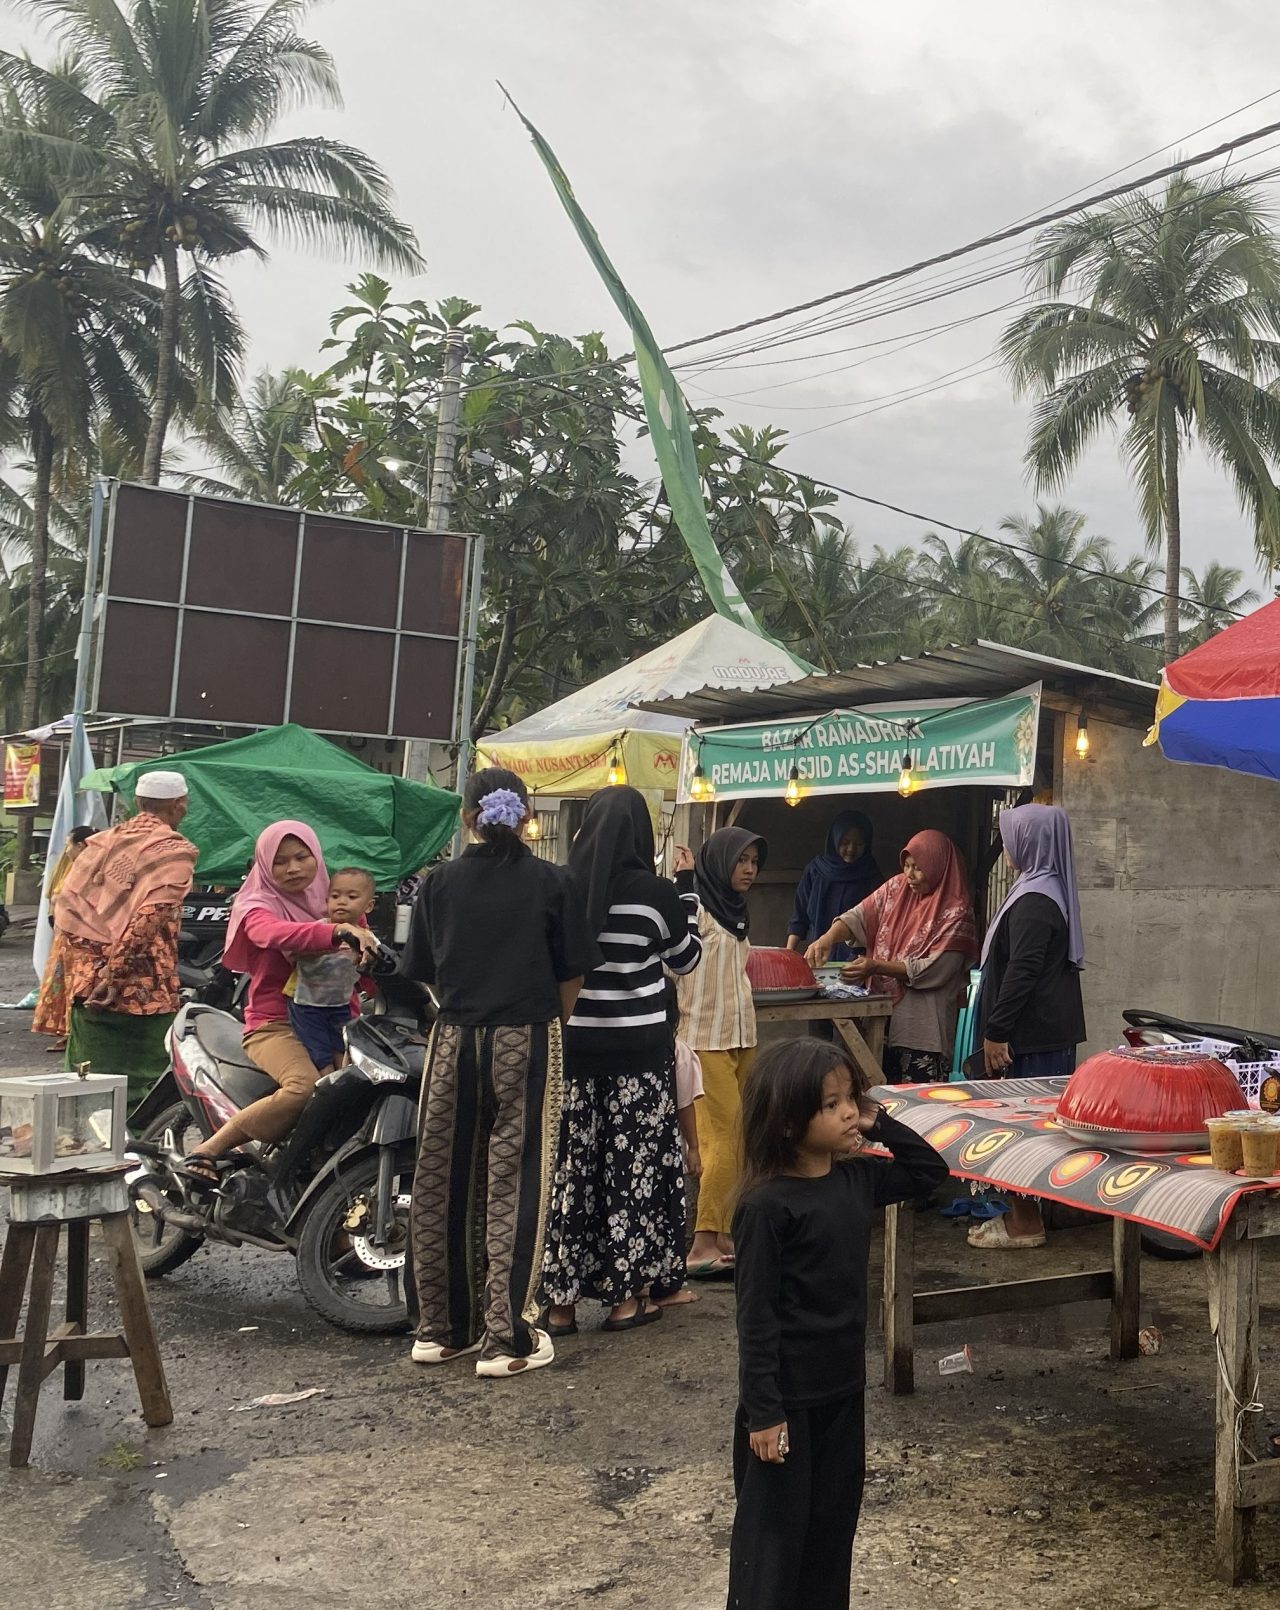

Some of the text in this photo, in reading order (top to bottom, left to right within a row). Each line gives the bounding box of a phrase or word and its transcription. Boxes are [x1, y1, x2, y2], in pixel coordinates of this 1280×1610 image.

[712, 665, 790, 680] MADUJAE
[761, 717, 925, 753] BAZAR RAMADHAN
[711, 760, 771, 785] REMAJA
[196, 906, 230, 921] PE
